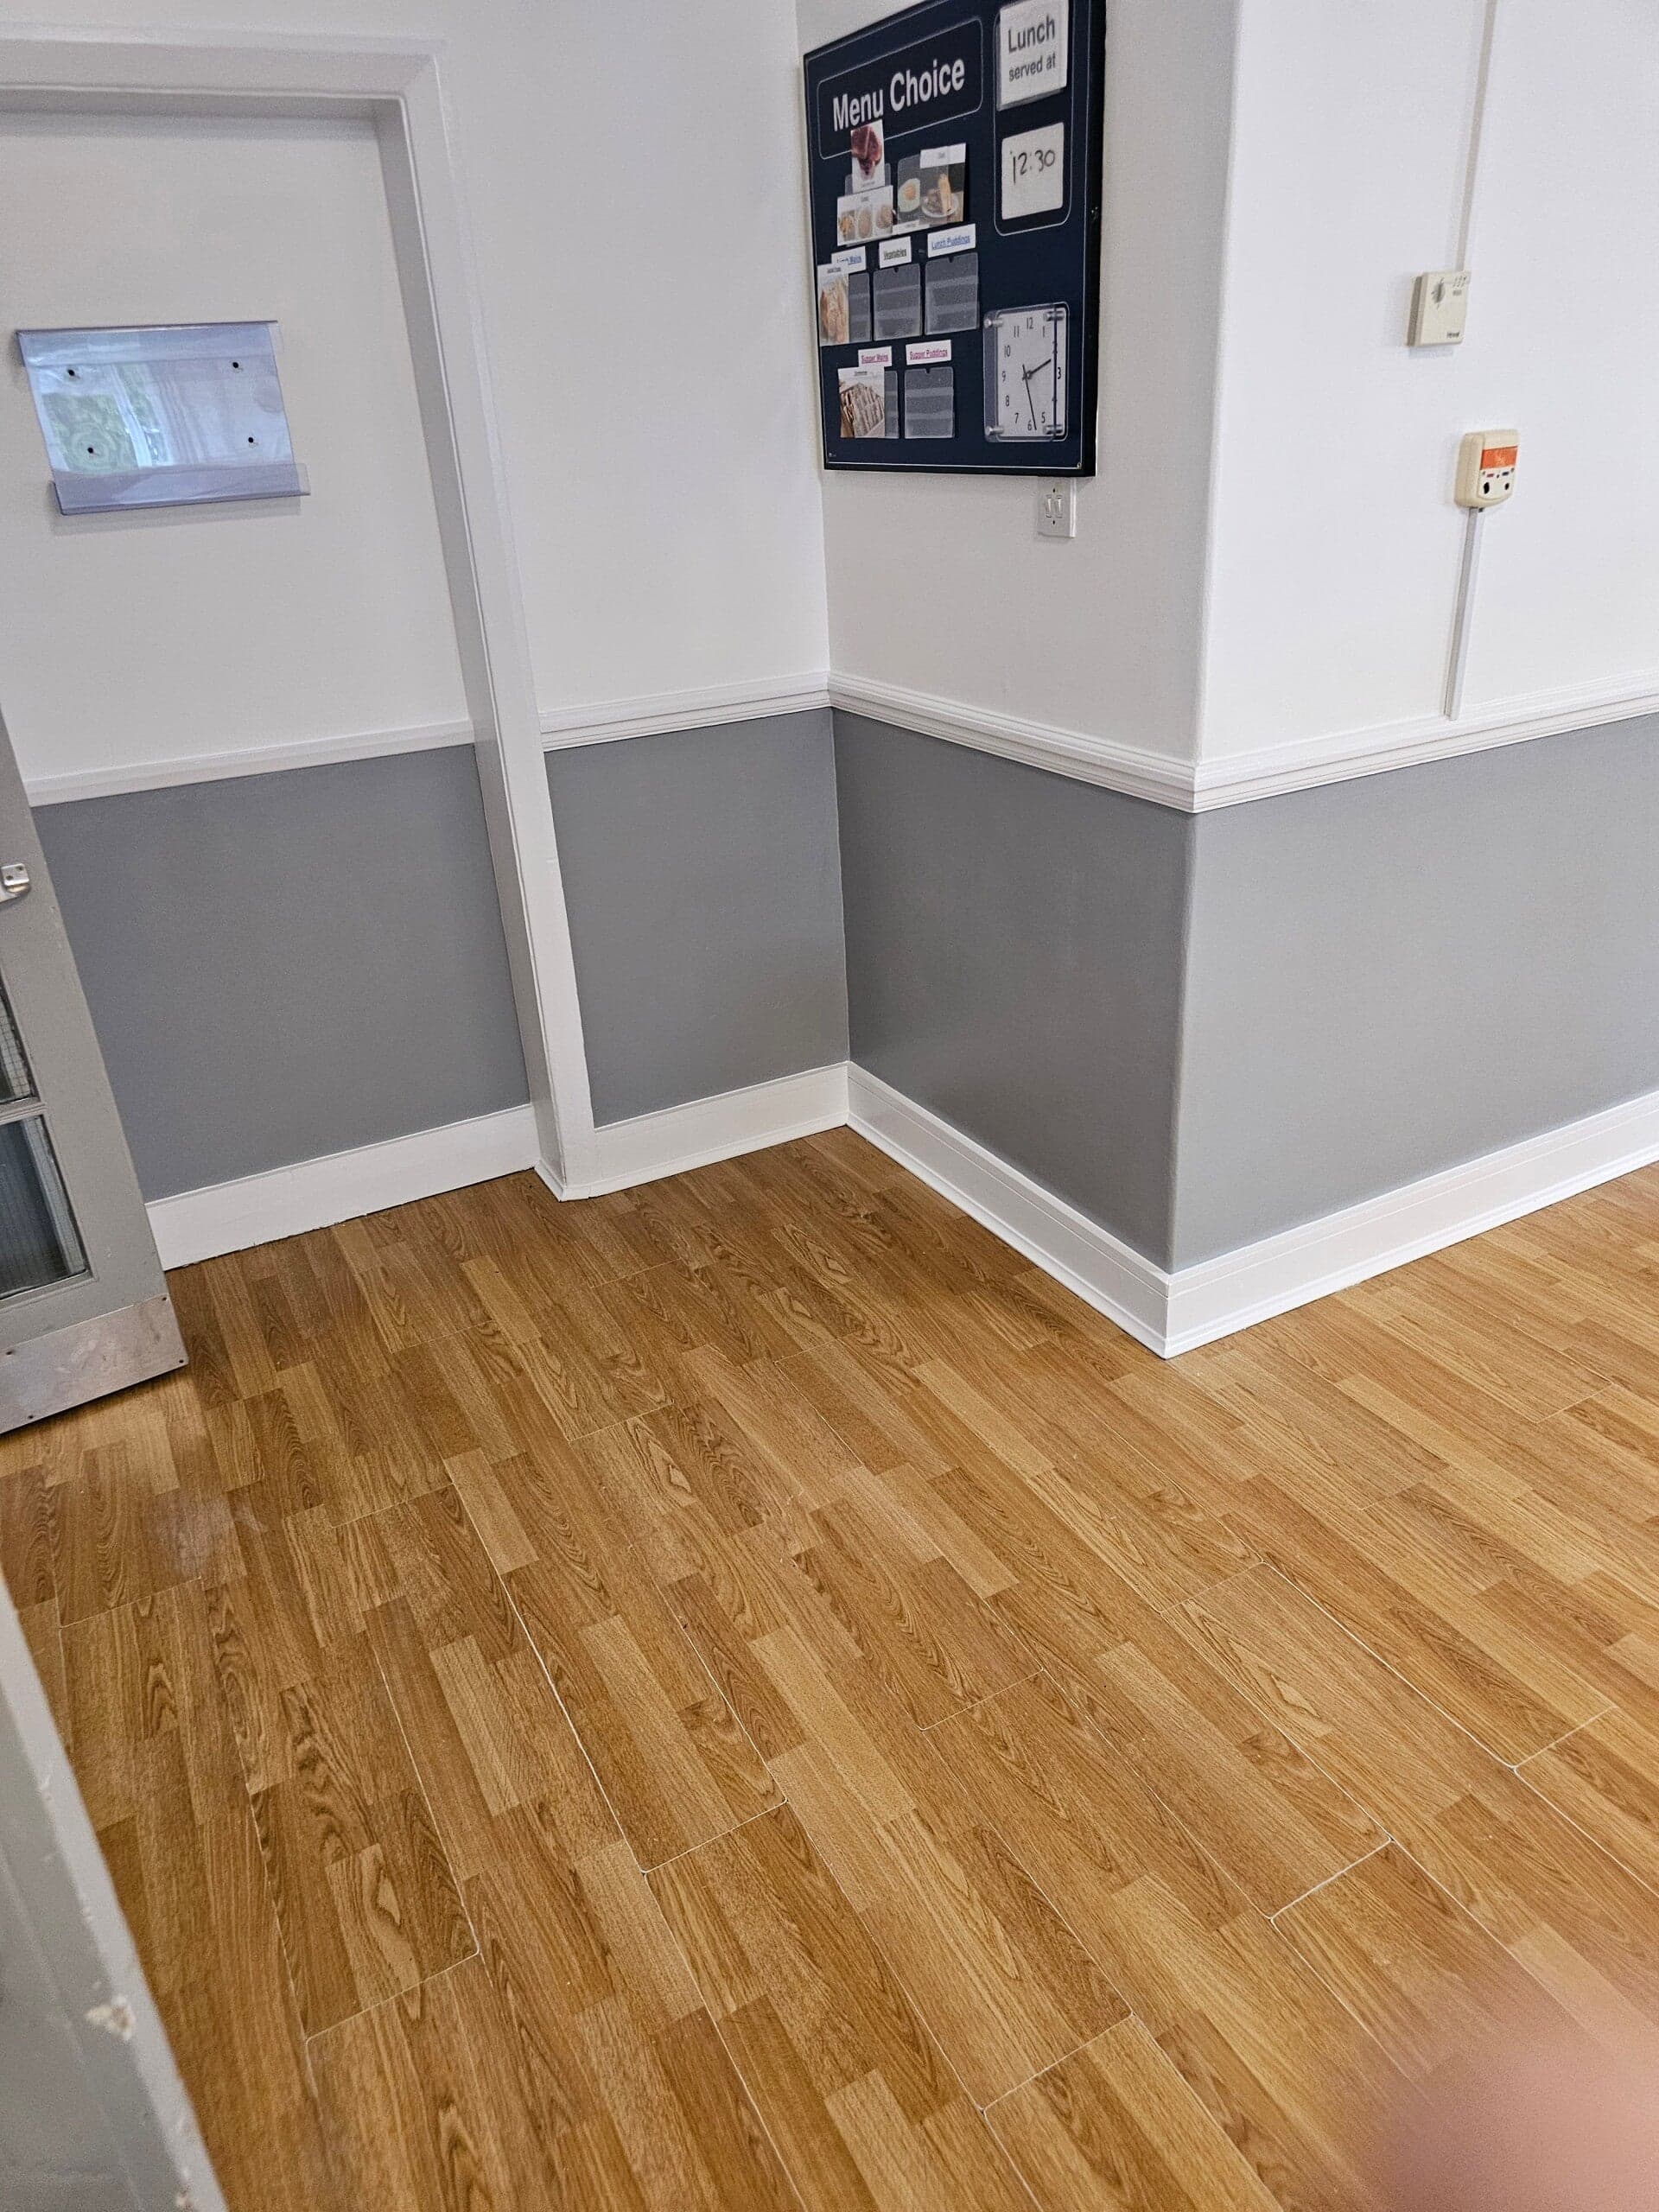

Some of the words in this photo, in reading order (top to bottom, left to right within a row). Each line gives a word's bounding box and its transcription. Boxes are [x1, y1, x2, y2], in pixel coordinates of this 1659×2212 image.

[1007, 13, 1055, 54] Lunch
[1008, 55, 1043, 82] served
[1046, 52, 1056, 71] at
[833, 89, 884, 131] Menu
[890, 58, 965, 111] Choice
[1009, 149, 1056, 185] 12:30
[1027, 317, 1033, 329] 12
[1014, 325, 1020, 338] 11
[1004, 345, 1011, 358] 10
[1057, 366, 1062, 379] 3
[1005, 395, 1010, 407] 8
[1014, 412, 1020, 424] 7
[1040, 411, 1046, 423] 5
[1027, 419, 1033, 431] 6
